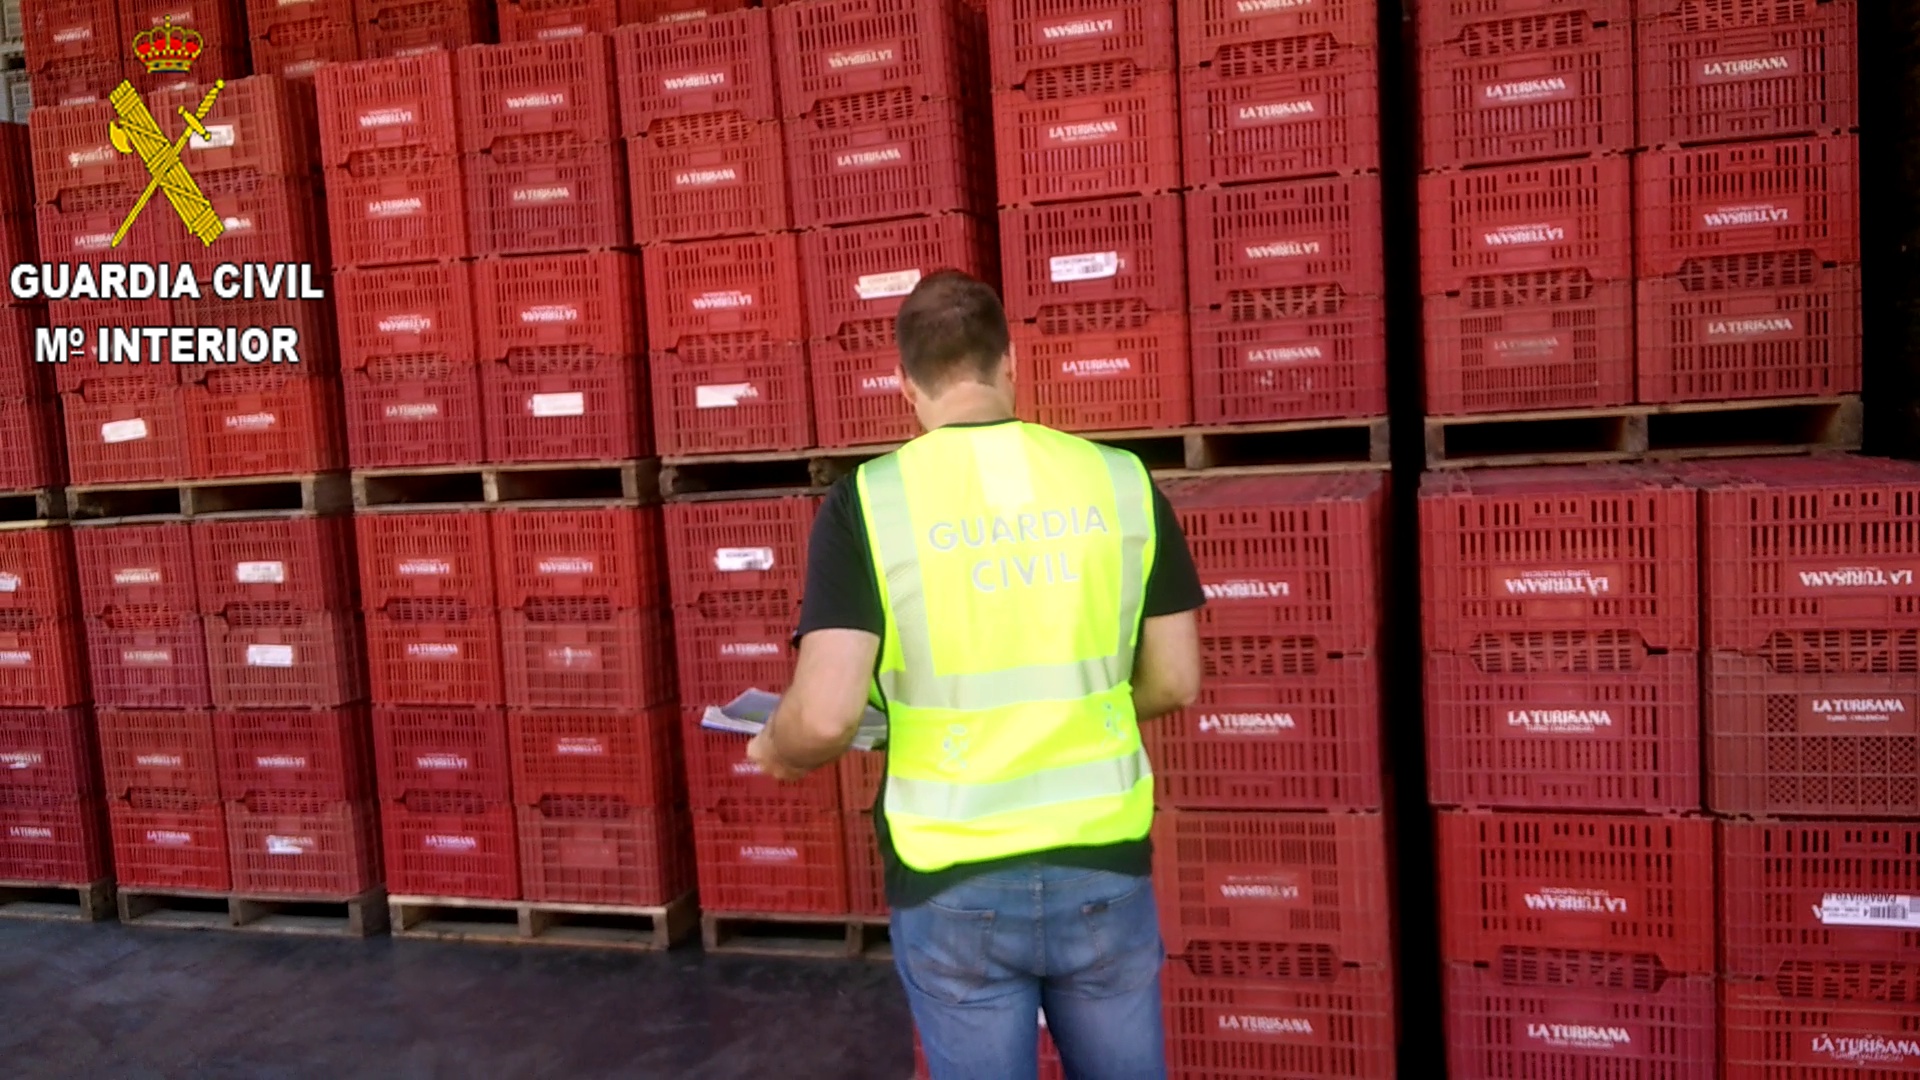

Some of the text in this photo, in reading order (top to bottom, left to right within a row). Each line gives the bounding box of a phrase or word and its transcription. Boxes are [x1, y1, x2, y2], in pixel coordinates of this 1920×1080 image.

[929, 505, 1107, 551] GUARDIA
[971, 552, 1079, 592] CIVIL
[1202, 583, 1267, 598] TURISAN
